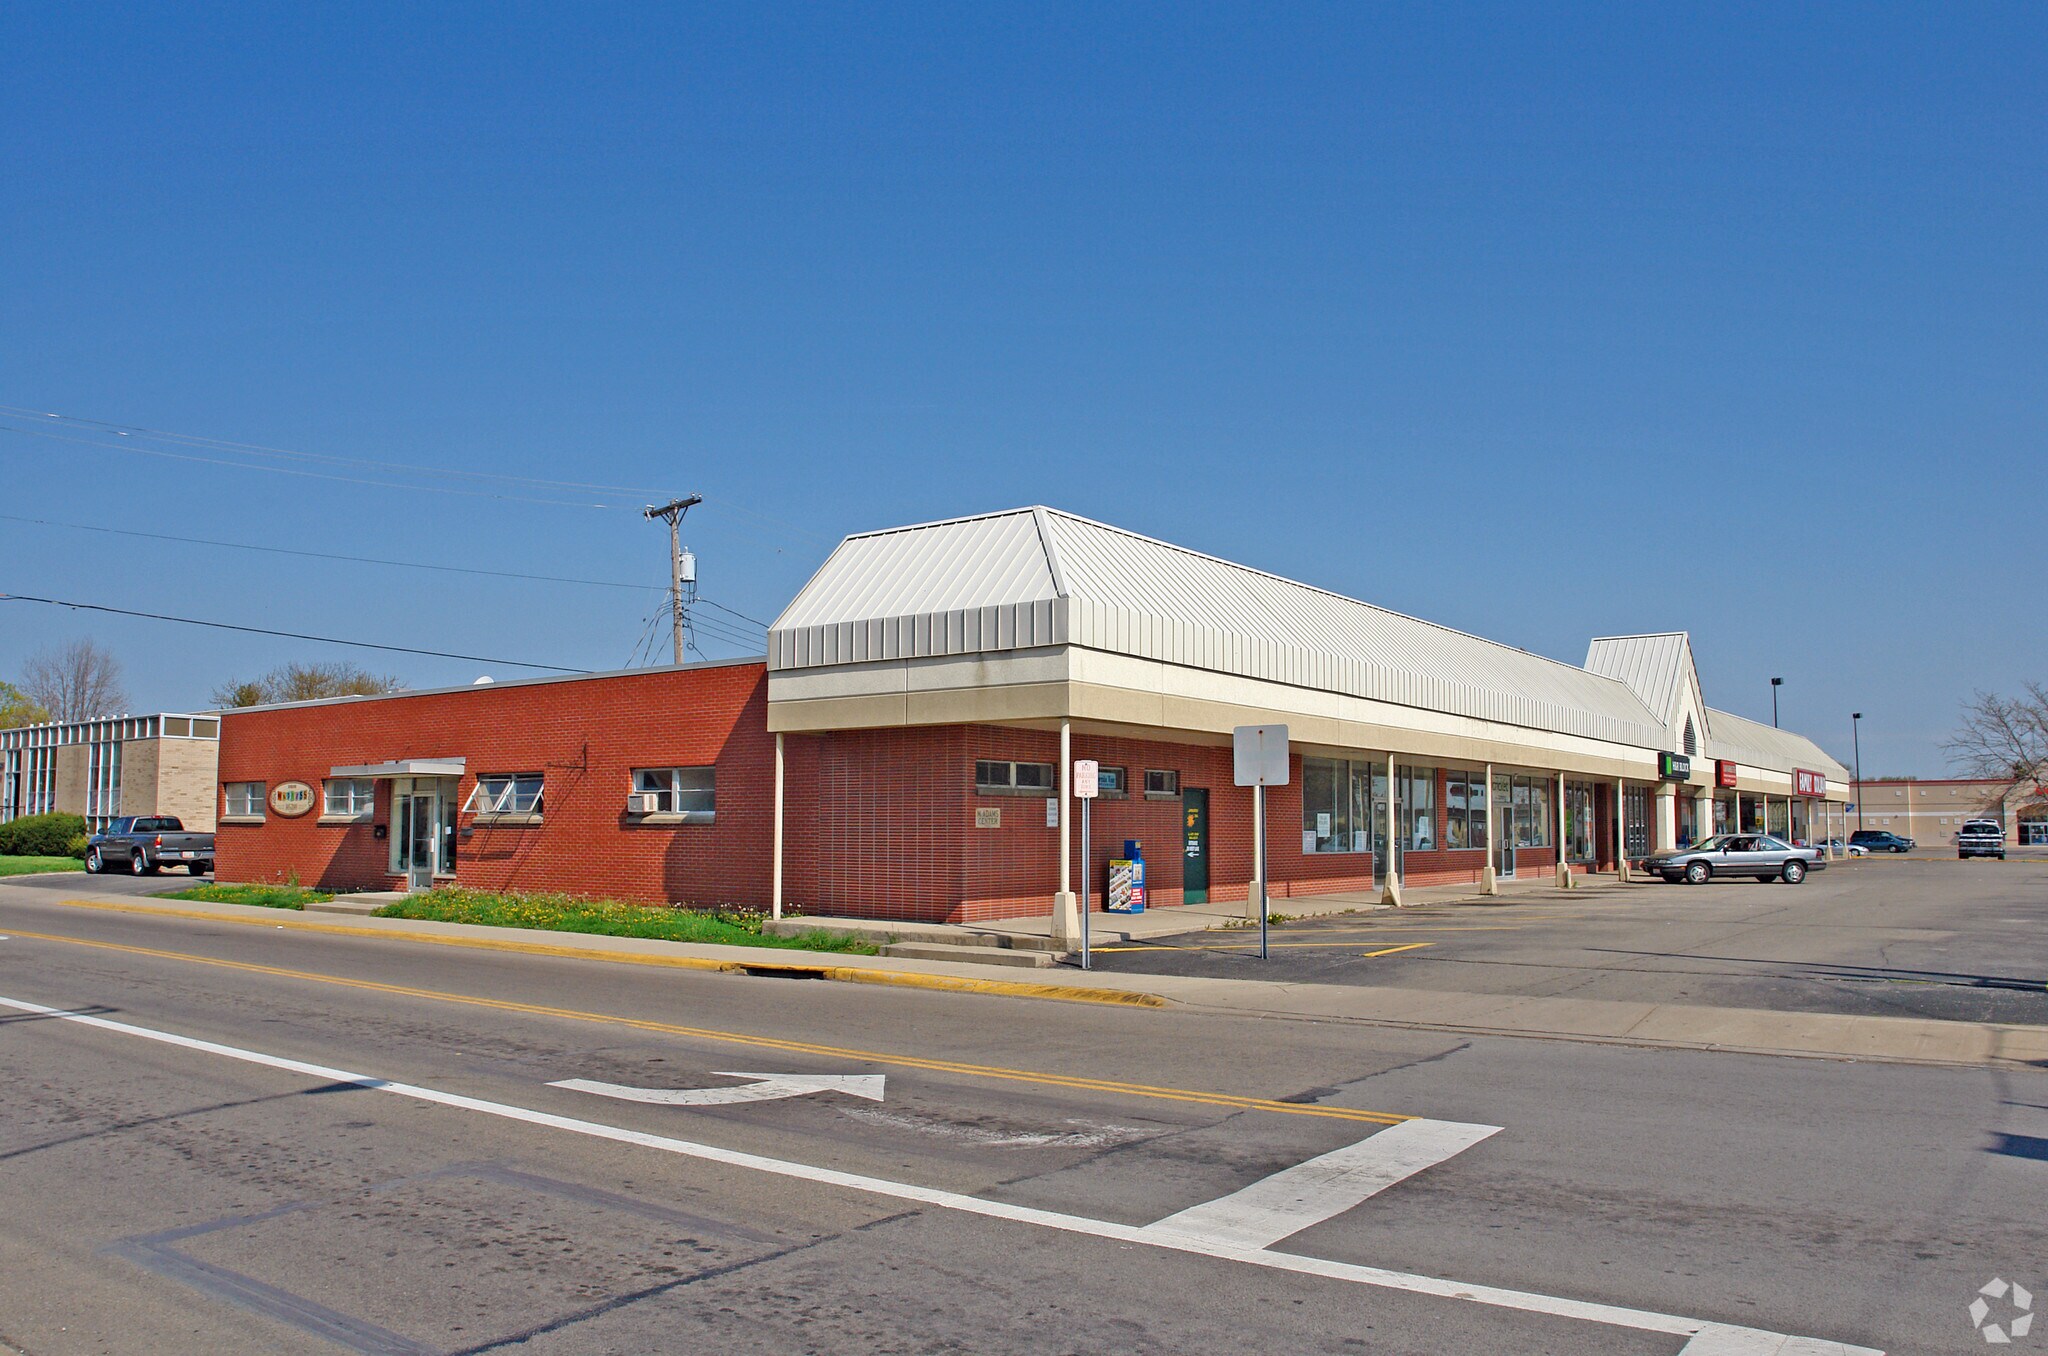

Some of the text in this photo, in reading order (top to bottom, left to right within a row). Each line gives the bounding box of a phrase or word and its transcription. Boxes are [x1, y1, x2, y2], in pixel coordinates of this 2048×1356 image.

[1679, 762, 1690, 772] BLOCK
[1799, 772, 1812, 792] FAMILY
[977, 817, 998, 825] CENTER
